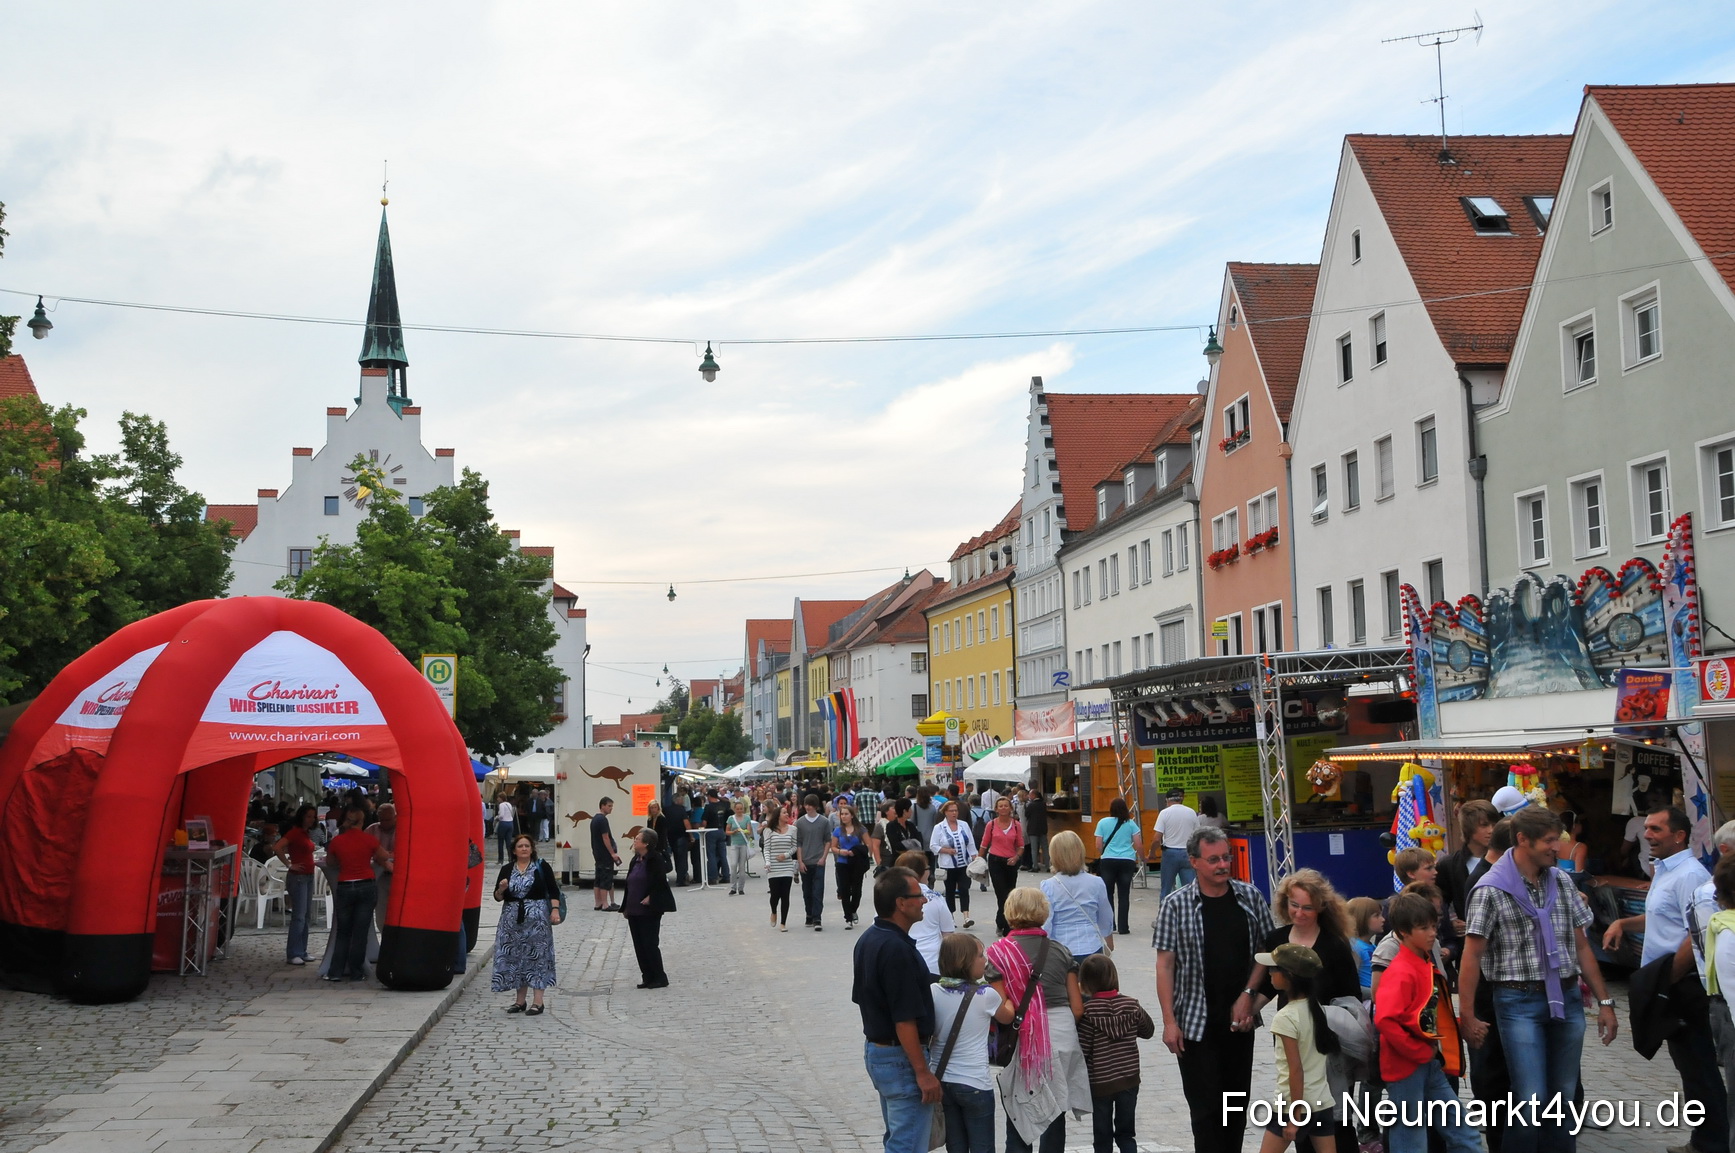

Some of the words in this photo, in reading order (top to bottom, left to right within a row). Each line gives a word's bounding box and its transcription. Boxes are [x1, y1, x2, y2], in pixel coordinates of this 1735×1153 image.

[1626, 674, 1664, 684] Donuts
[247, 680, 340, 700] Charivari
[229, 698, 257, 712] WIR
[257, 702, 285, 713] SPIELEN
[286, 705, 295, 713] DIE
[296, 700, 359, 714] KLASSIKER
[1284, 698, 1318, 718] Clu
[229, 731, 360, 742] www.charivari.com
[1157, 747, 1175, 755] New
[1177, 745, 1200, 754] Berlin
[1202, 744, 1218, 753] Club
[1158, 754, 1220, 766] Altstadtfest
[1637, 752, 1670, 766] COFFEE
